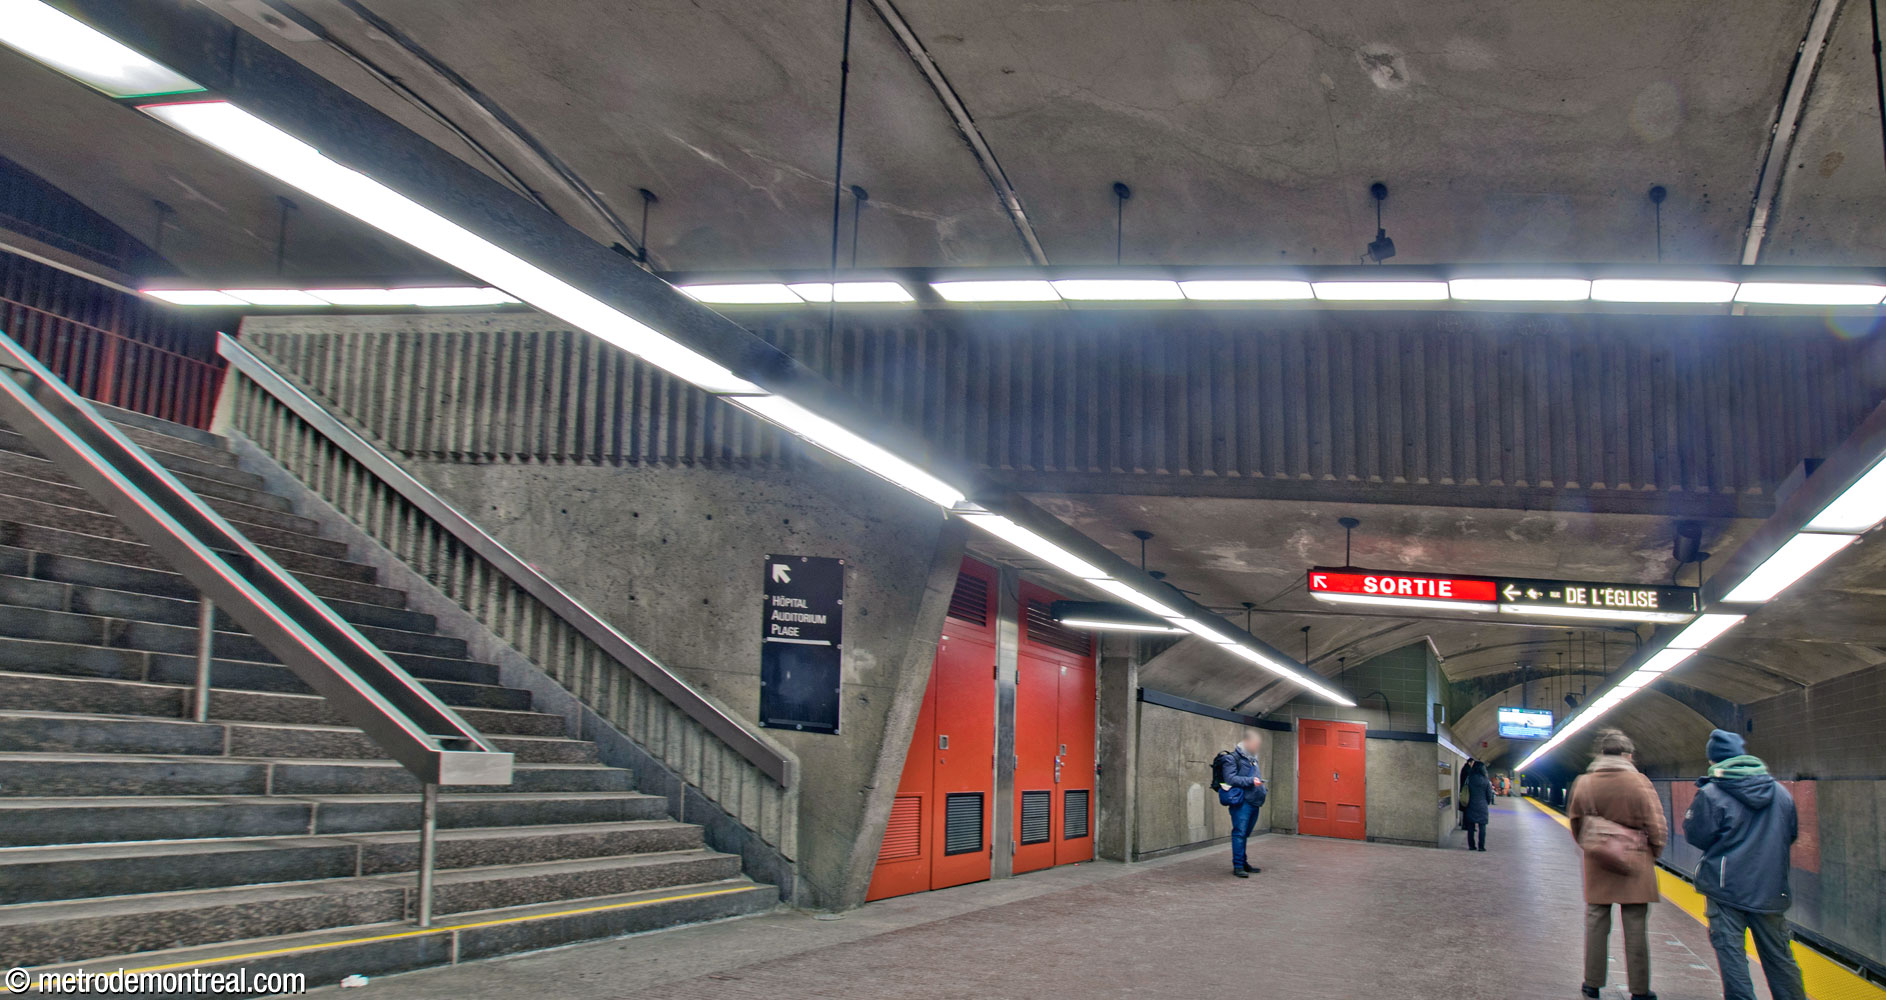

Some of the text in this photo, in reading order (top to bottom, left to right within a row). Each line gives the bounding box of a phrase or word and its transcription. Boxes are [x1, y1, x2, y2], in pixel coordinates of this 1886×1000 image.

[1363, 576, 1452, 597] SORTIE
[772, 595, 808, 608] HÔPITAL
[1565, 587, 1587, 604] DE
[1591, 586, 1658, 608] L'ÉGLISE
[771, 610, 827, 624] AUDITORIUM
[771, 624, 800, 637] PLAGE
